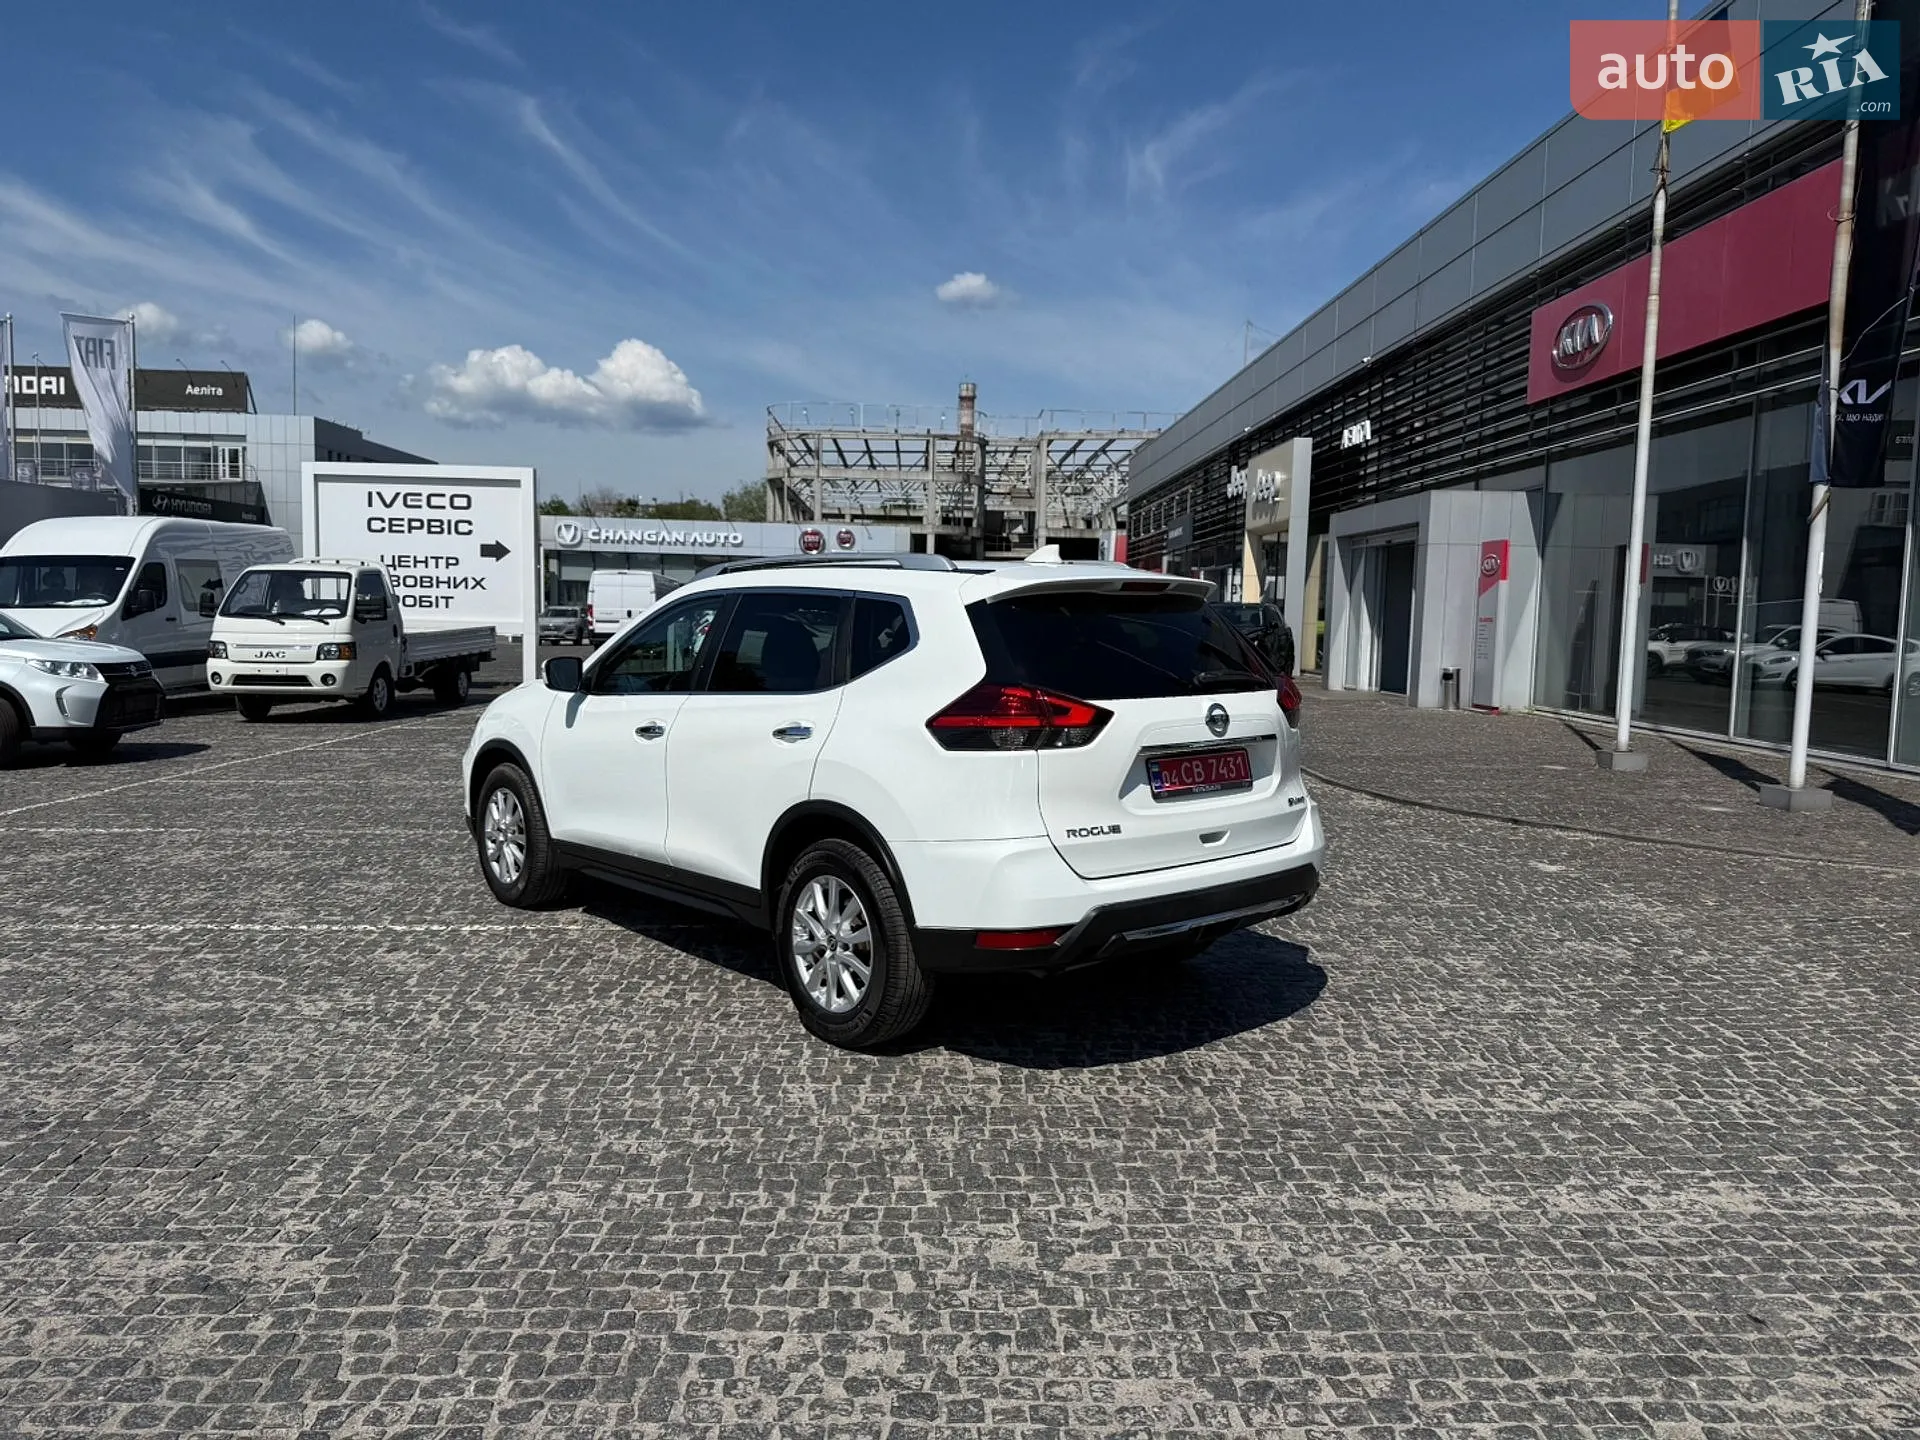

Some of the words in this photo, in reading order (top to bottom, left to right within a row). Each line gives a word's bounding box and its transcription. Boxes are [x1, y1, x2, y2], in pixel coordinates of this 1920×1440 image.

[185, 384, 223, 396] Аеліта
[367, 490, 472, 510] IVECO
[366, 516, 474, 536] СЕРВІС
[588, 527, 686, 545] CHANGAN
[688, 532, 743, 547] AUTO
[380, 554, 460, 571] ЦЕНТР
[254, 650, 287, 659] JAC
[1162, 770, 1180, 785] 04
[1181, 759, 1205, 784] CB
[1208, 755, 1246, 779] 7431
[1066, 824, 1122, 838] ROGUE
